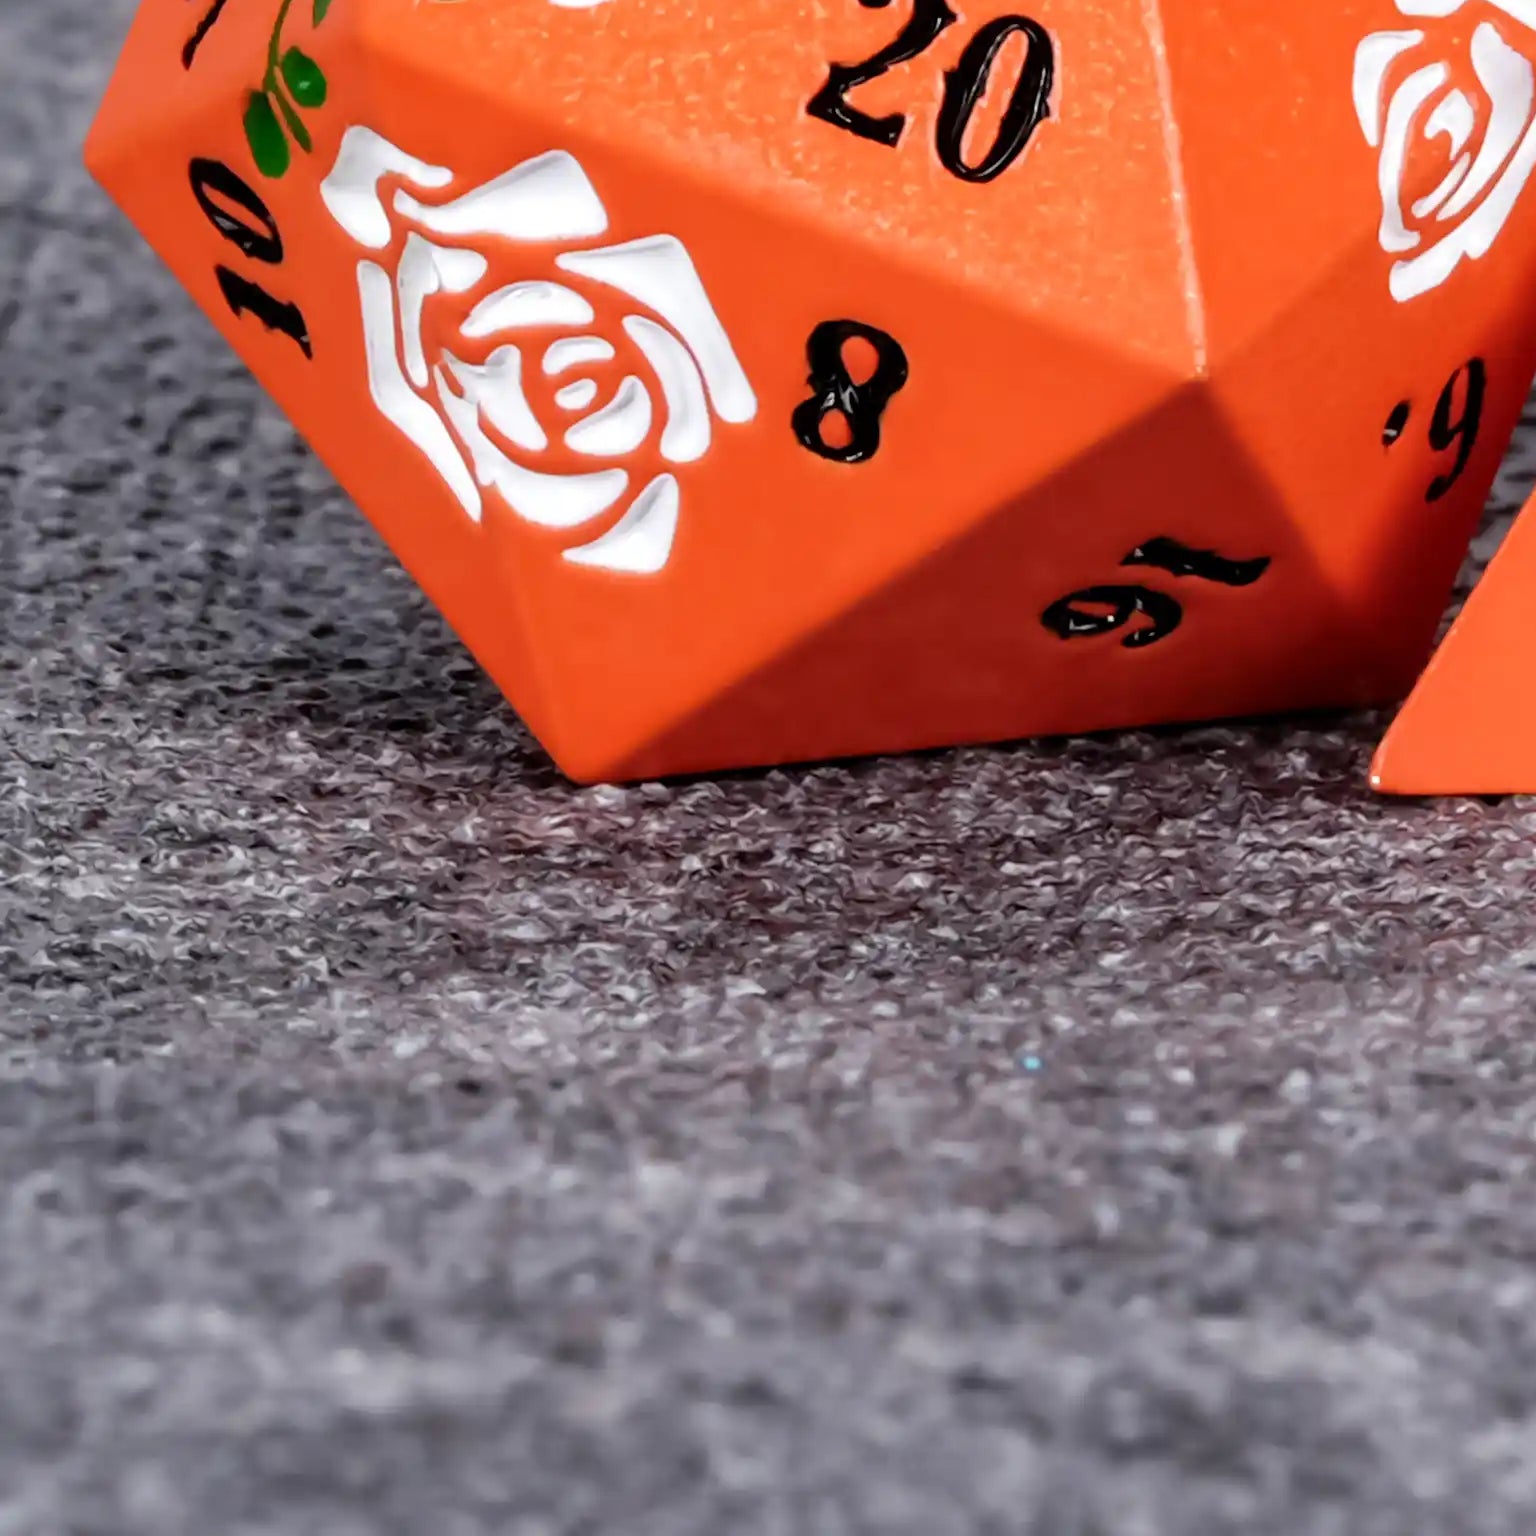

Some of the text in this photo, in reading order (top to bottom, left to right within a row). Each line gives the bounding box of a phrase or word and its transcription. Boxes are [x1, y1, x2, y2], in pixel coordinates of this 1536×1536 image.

[188, 157, 313, 359] 10
[791, 319, 909, 464] 8
[1039, 535, 1272, 648] 16
